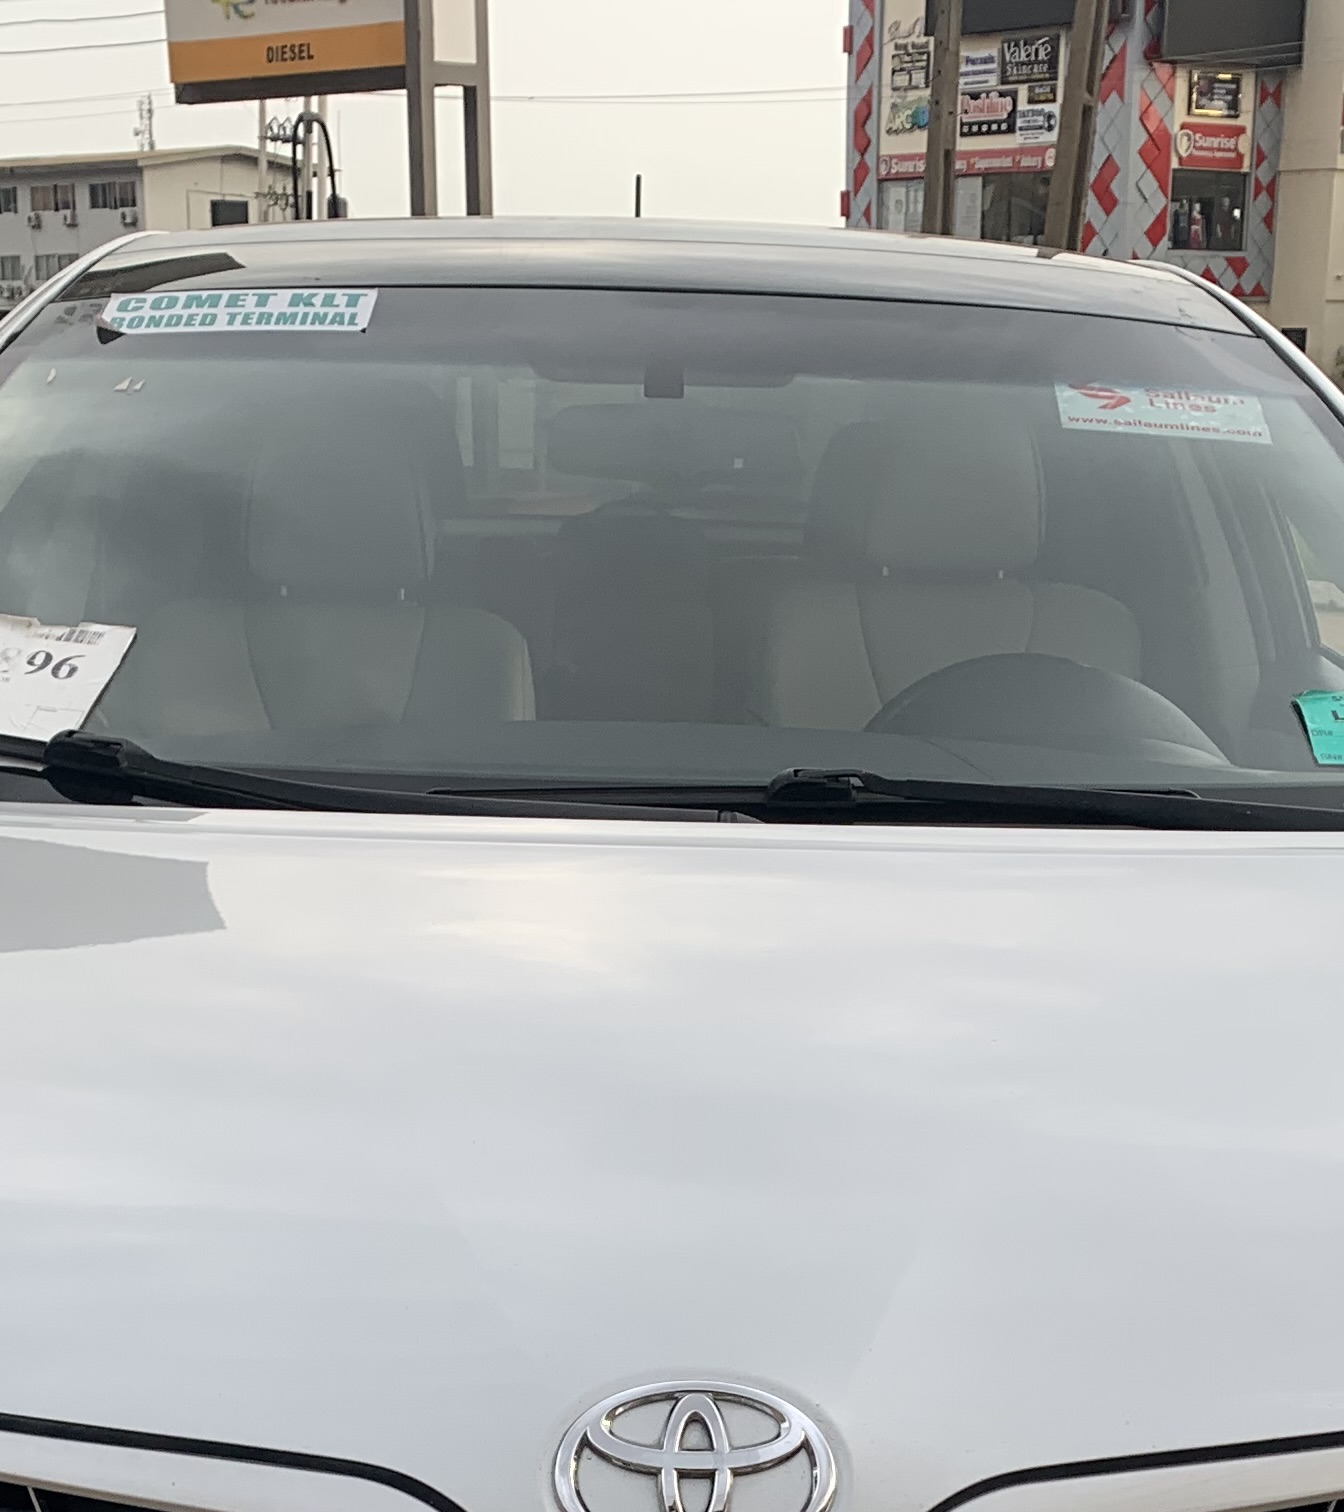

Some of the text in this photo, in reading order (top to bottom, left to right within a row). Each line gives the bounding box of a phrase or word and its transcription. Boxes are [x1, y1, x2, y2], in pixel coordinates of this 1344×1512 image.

[266, 43, 314, 64] DIESEL
[1006, 63, 1049, 75] Skincare
[1195, 133, 1237, 149] Sunrise
[890, 157, 926, 174] Sunris
[115, 293, 369, 313] COMET KLT
[111, 311, 360, 329] BONDED TERMINAL
[1149, 398, 1216, 413] Lines
